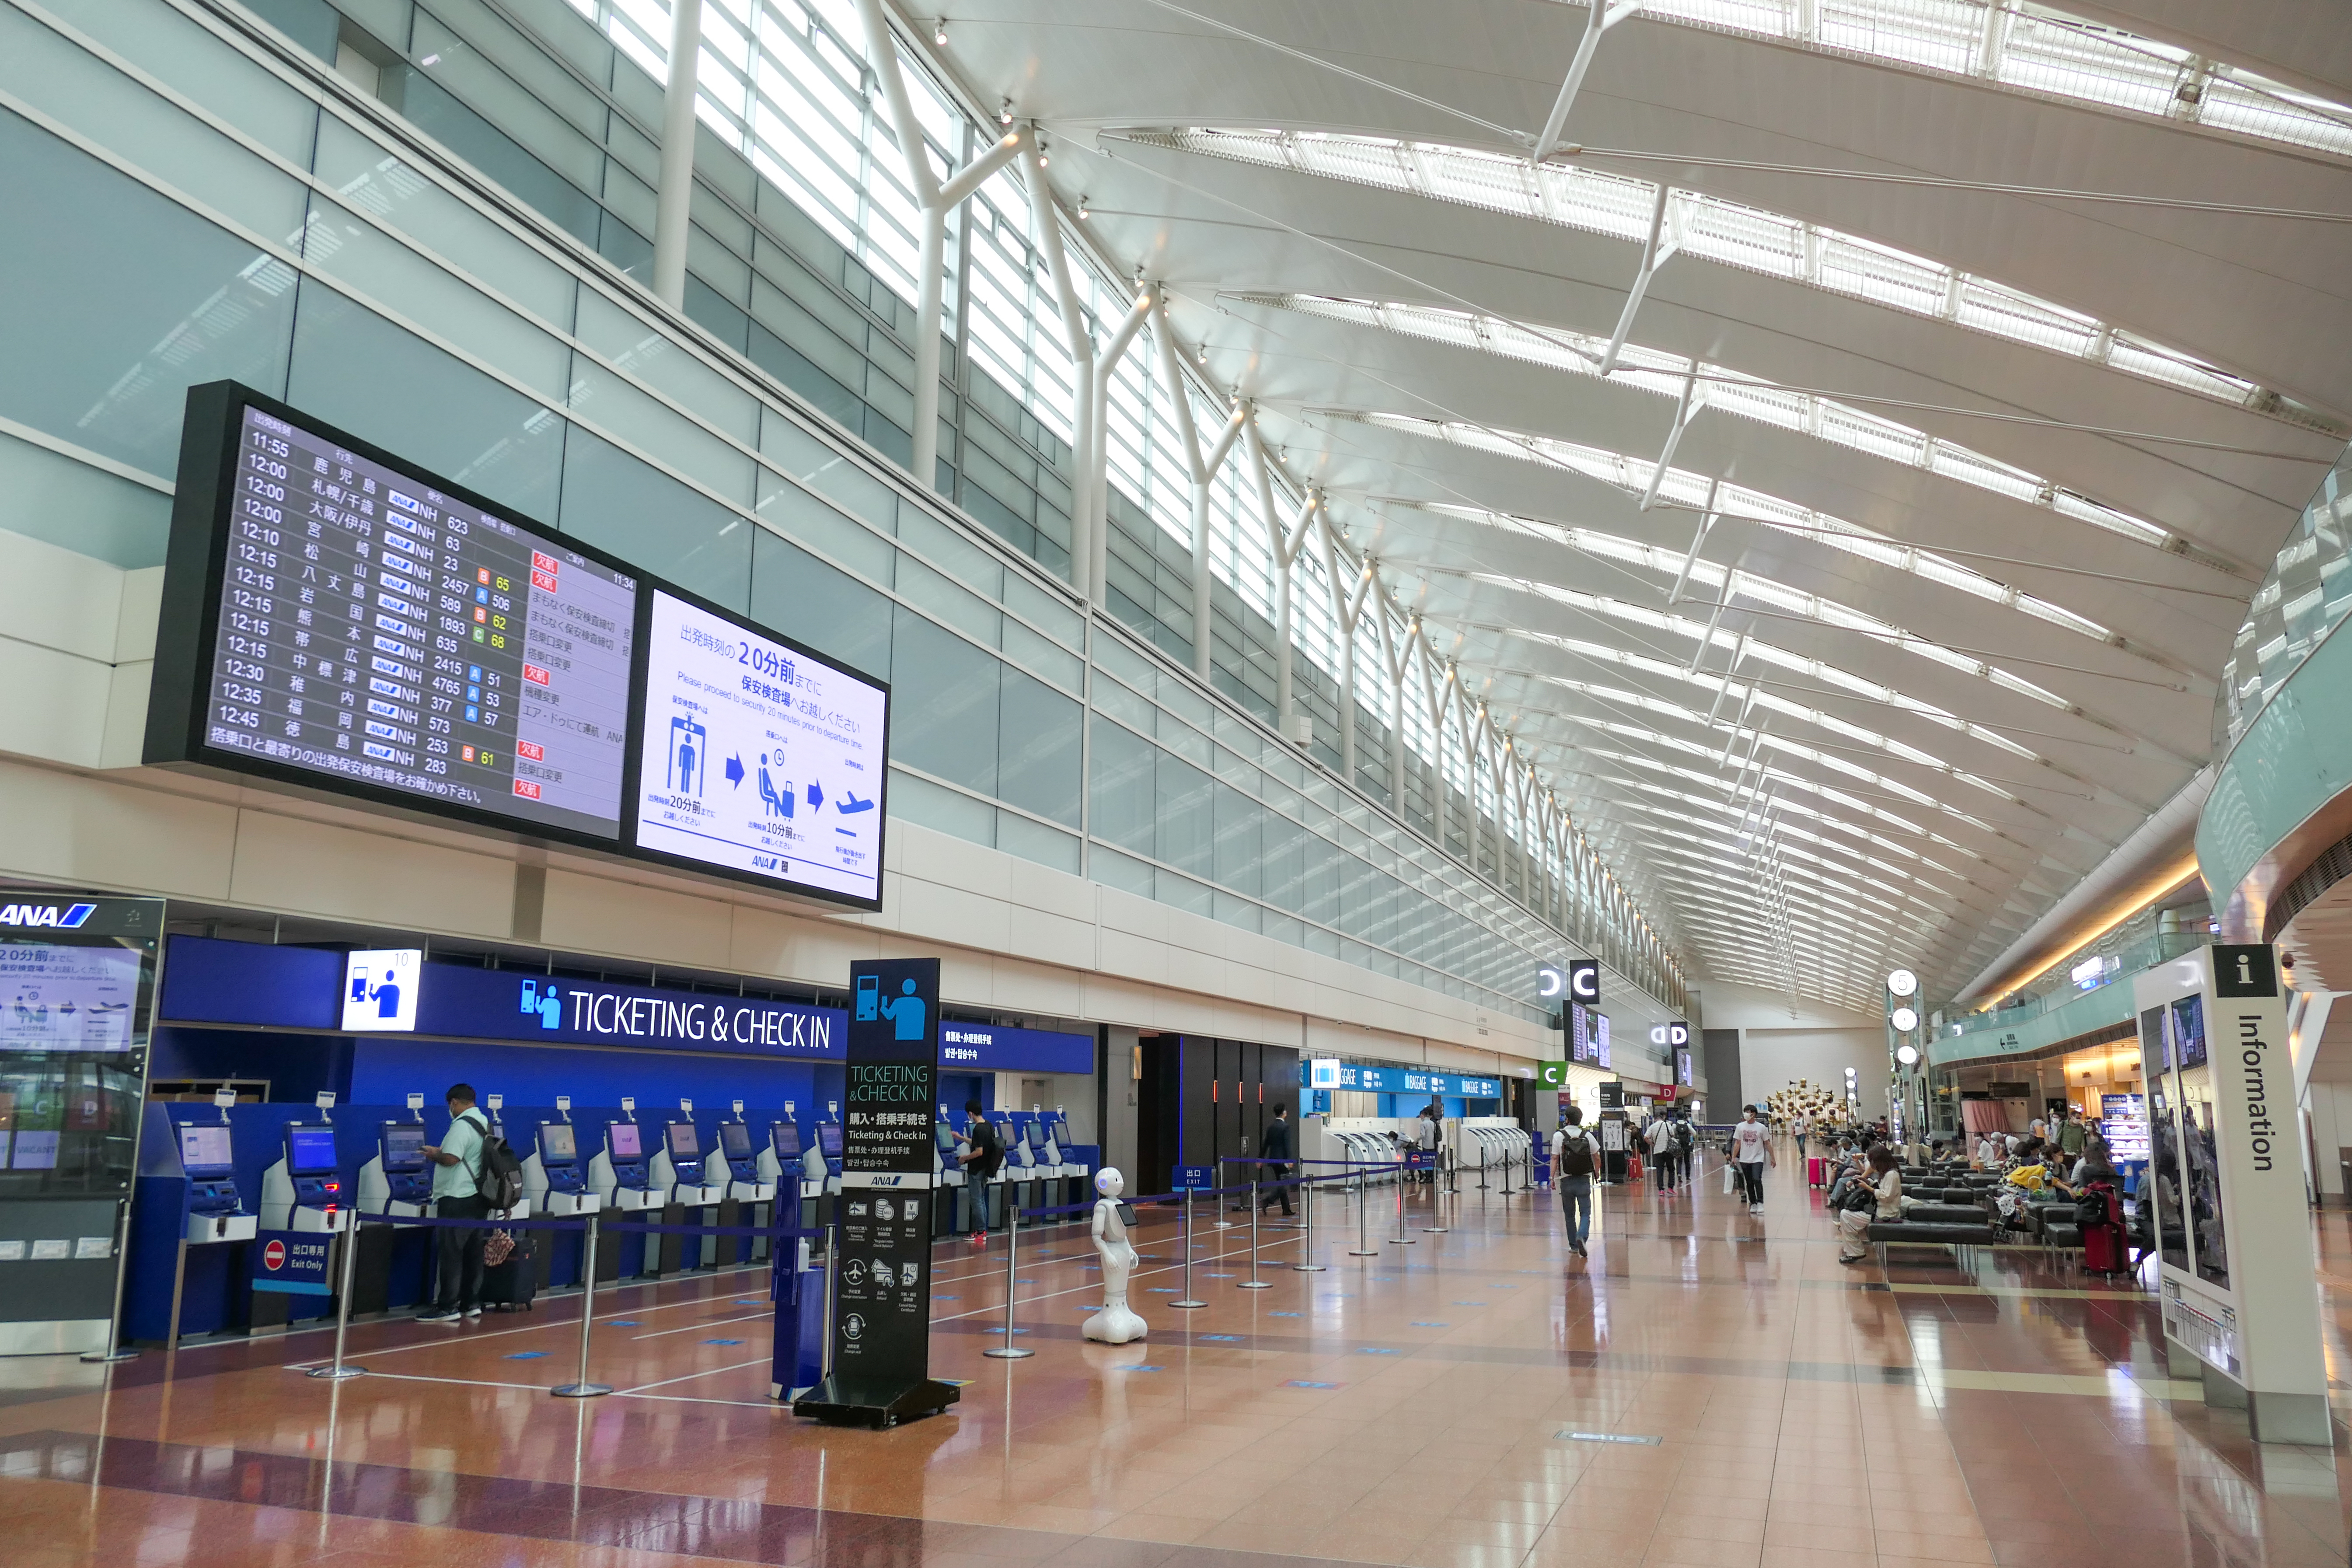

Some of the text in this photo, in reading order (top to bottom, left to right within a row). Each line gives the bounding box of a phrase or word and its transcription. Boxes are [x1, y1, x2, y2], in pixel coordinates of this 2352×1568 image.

[251, 430, 290, 459] 11:55
[314, 455, 377, 496] 鹿児島
[419, 503, 438, 523] NH
[447, 515, 468, 536] 623
[537, 552, 555, 573] 欠航
[246, 474, 285, 503] 12:00
[309, 498, 372, 538] 大阪/伊丹
[415, 543, 434, 562] NH
[443, 554, 458, 572] 23
[480, 570, 488, 582] B
[496, 575, 510, 592] 65
[249, 452, 287, 481] 12:00
[417, 523, 436, 543] NH
[445, 534, 460, 552] 63
[535, 571, 554, 591] 欠航
[243, 496, 282, 525] 12:00
[413, 563, 432, 583] NH
[441, 574, 469, 597] 2457
[478, 590, 486, 601] A
[492, 593, 510, 612] 506
[241, 519, 279, 547] 12:10
[411, 583, 430, 603] NH
[440, 594, 461, 614] 589
[476, 609, 484, 621] B
[492, 613, 506, 630] 62
[528, 627, 572, 654] 搭乗口変更
[613, 572, 633, 590] 11:34
[238, 541, 277, 569] 12:15
[301, 563, 366, 601] 八丈島
[409, 604, 428, 623] NH
[437, 614, 466, 636] 1893
[475, 629, 482, 640] C
[491, 632, 505, 650] 68
[527, 646, 571, 673] 搭乗口変更
[233, 587, 272, 614] 12:15
[405, 645, 424, 664] NH
[434, 654, 462, 675] 2415
[471, 668, 479, 679] A
[487, 671, 501, 688] 51
[235, 564, 274, 592] 12:15
[299, 585, 363, 622] 岩国
[407, 624, 426, 643] NH
[436, 634, 457, 653] 635
[527, 664, 546, 684] 欠航
[230, 610, 269, 637] 12:15
[403, 665, 422, 684] NH
[432, 674, 460, 695] 4765
[469, 688, 477, 699] A
[485, 691, 500, 707] 53
[227, 633, 267, 660] 12:15
[401, 686, 420, 705] NH
[430, 695, 452, 714] 377
[468, 707, 475, 719] A
[484, 710, 498, 727] 57
[224, 657, 264, 682] 12:30
[399, 707, 419, 725] NH
[428, 715, 450, 734] 573
[520, 740, 540, 759] 欠航
[677, 671, 701, 689] Please
[703, 681, 732, 703] proceed
[733, 693, 740, 704] to
[741, 695, 765, 716] security
[768, 705, 776, 718] 20
[777, 709, 800, 727] minutes
[802, 719, 815, 734] prior
[816, 725, 822, 735] to
[823, 726, 850, 747] departure
[741, 674, 860, 736] 保安検査場へお越しください
[221, 680, 262, 705] 12:35
[286, 696, 352, 729] 福岡
[397, 728, 416, 746] NH
[426, 736, 448, 754] 253
[464, 747, 471, 758] B
[480, 750, 495, 766] 61
[517, 760, 562, 783] 搭乗口変更
[219, 704, 259, 728] 12:45
[394, 749, 415, 767] NH
[424, 756, 446, 775] 283
[517, 779, 537, 797] 欠航
[752, 855, 770, 869] ANA
[0, 904, 57, 927] ANA
[395, 953, 408, 966] 10
[2237, 954, 2253, 983] i
[1574, 968, 1595, 995] C
[1898, 975, 1907, 990] 5
[569, 991, 830, 1048] TICKETING & CHECK IN
[1672, 1027, 1687, 1044] D
[851, 1066, 928, 1082] TICKETING
[1410, 1075, 1427, 1090] BAGGAGE
[1545, 1067, 1557, 1083] C
[912, 1085, 927, 1101] IN
[1664, 1089, 1671, 1097] D
[2239, 1015, 2275, 1171] Information
[849, 1113, 927, 1125] 購入・搭乗手続き
[848, 1131, 926, 1141] Ticketing & Check In
[871, 1176, 891, 1185] ANA
[293, 1244, 325, 1256] 出口専用
[291, 1259, 323, 1271] Exit Only
